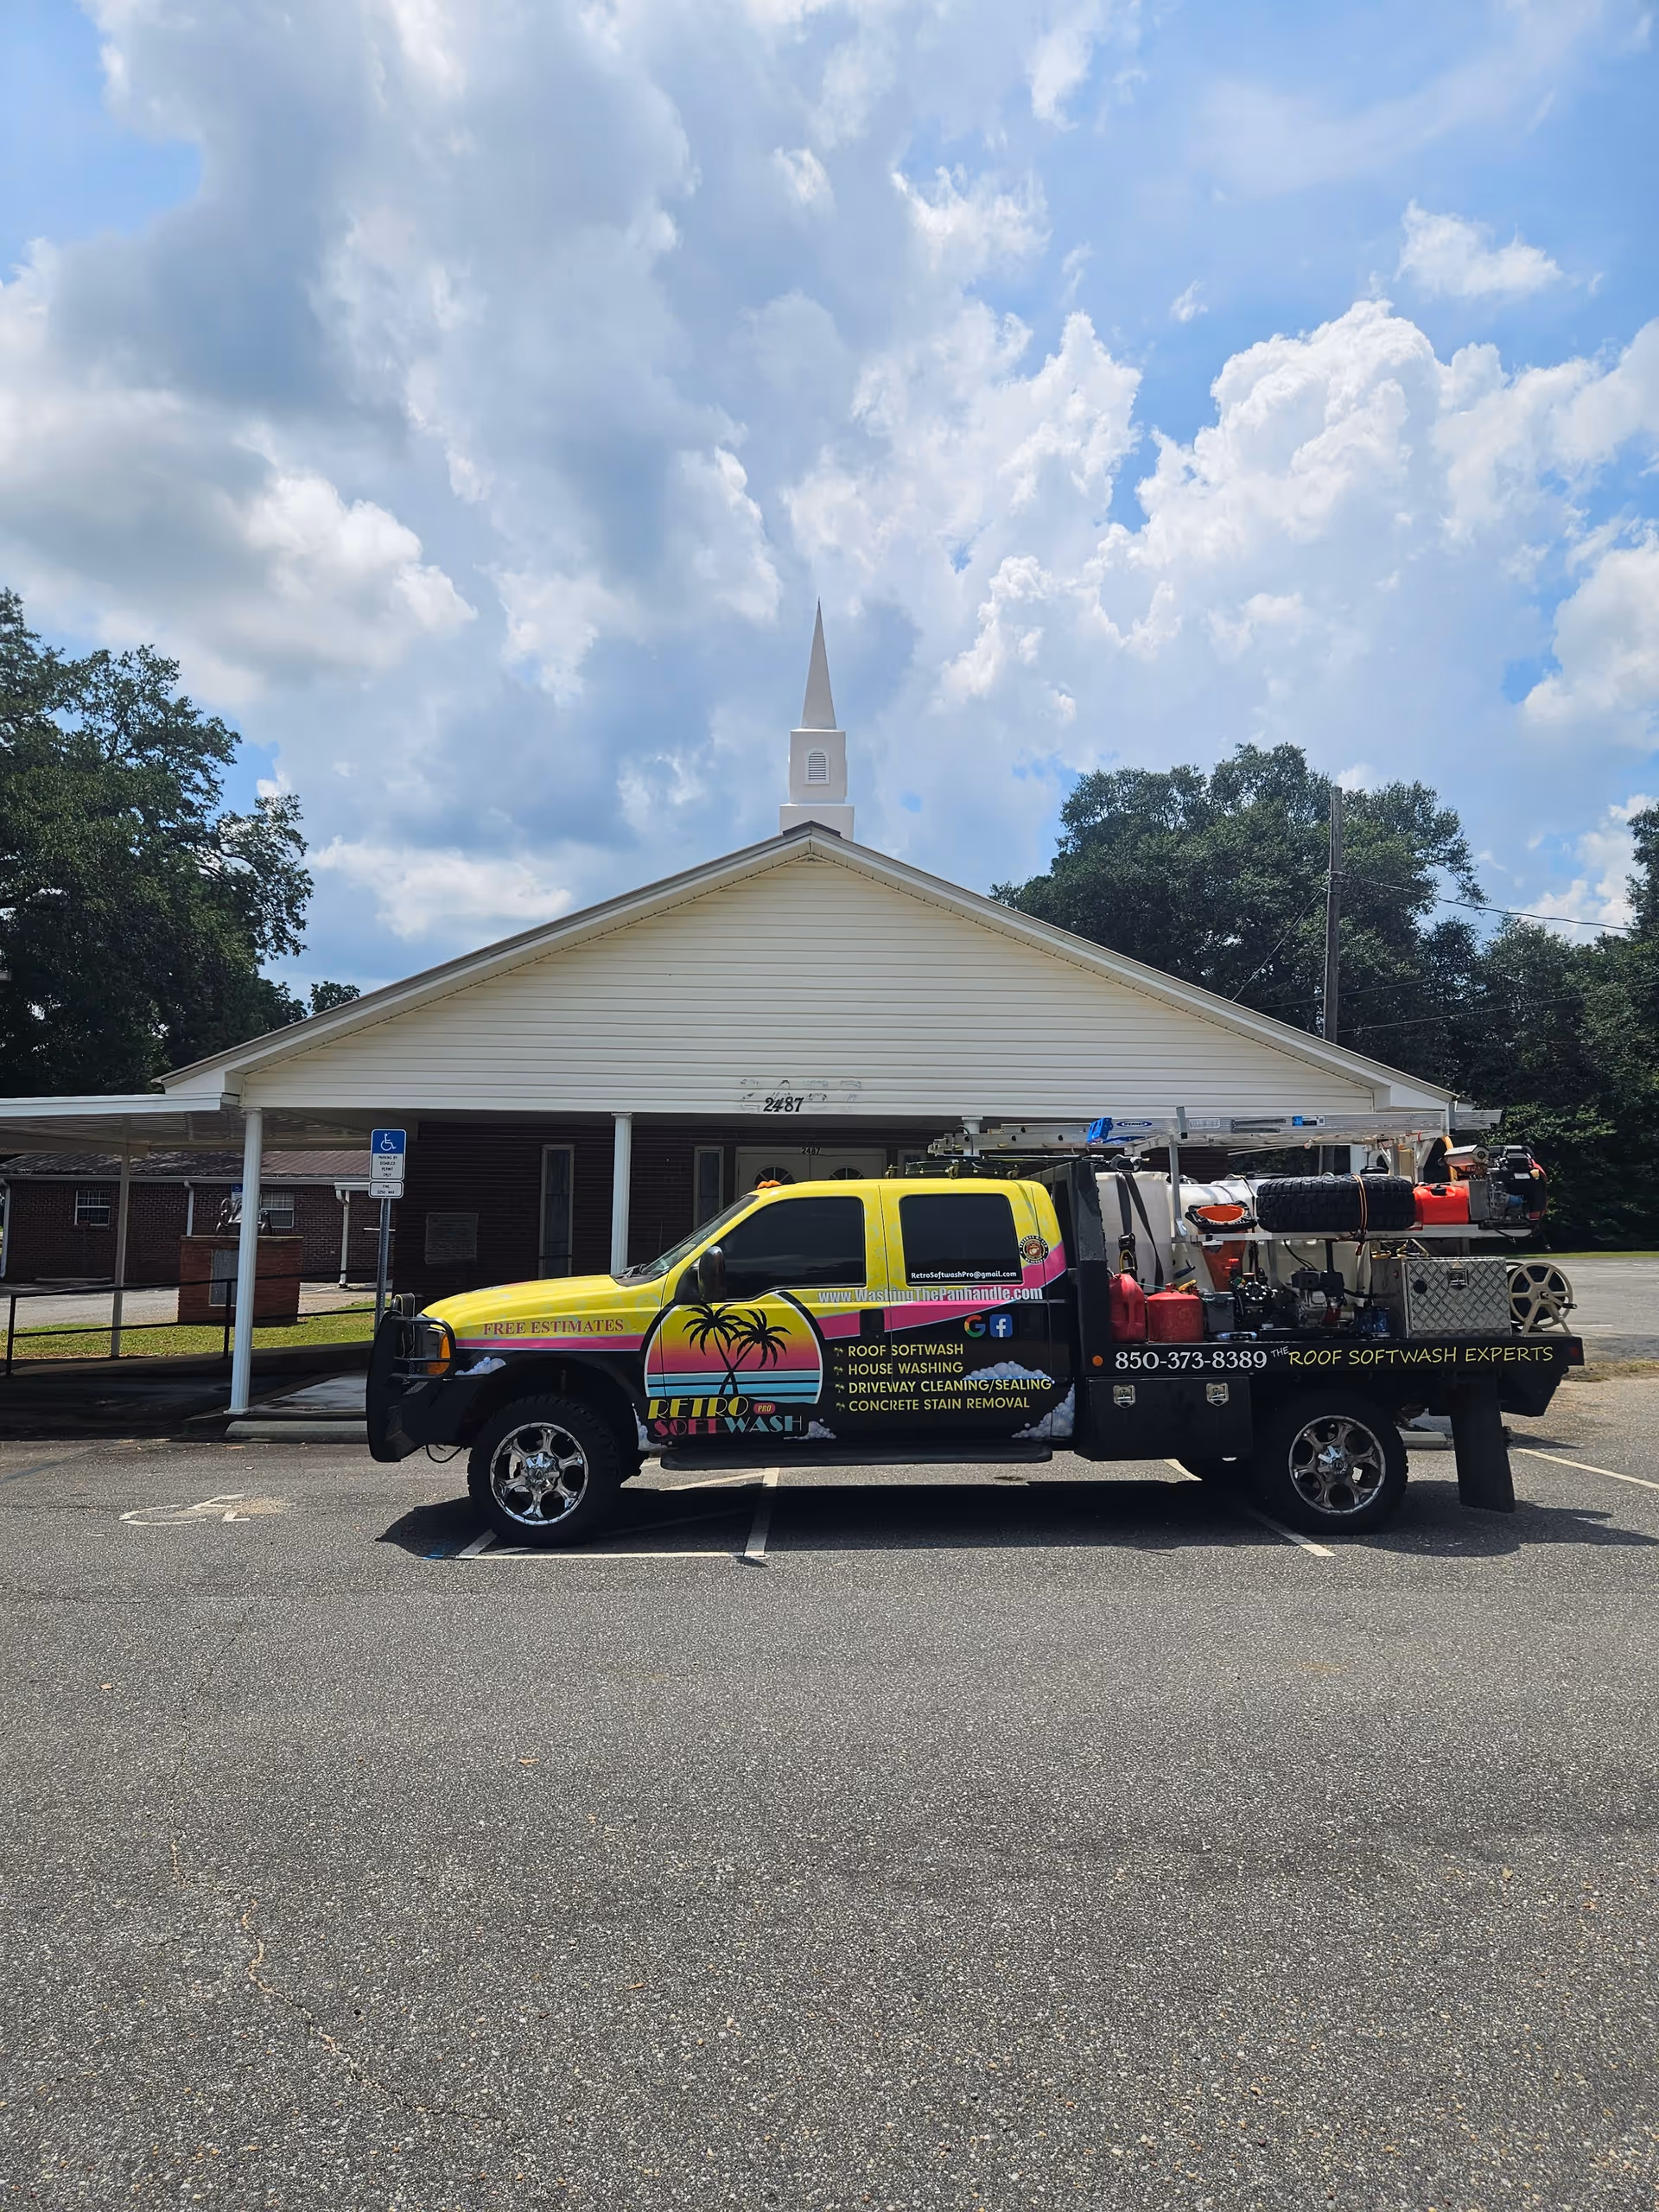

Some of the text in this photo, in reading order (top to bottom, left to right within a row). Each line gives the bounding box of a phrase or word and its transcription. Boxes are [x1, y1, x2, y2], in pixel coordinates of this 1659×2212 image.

[763, 1096, 804, 1113] 2487
[801, 1147, 821, 1155] 2487
[912, 1271, 1017, 1281] RetroSoftwashPro@gmail.com
[818, 1286, 1044, 1303] www.WashingThePanhandle.com
[484, 1319, 624, 1335] FREE ESTIMATES
[848, 1344, 963, 1357] ROOF SOFTWASH
[1115, 1346, 1554, 1370] 850-373-8389 THE ROOF SOFTWASH EXPERTS
[849, 1362, 963, 1376] HOUSE WASHING
[849, 1378, 1052, 1394] DRIVEWAY CLEANING/SEALING
[648, 1396, 772, 1420] RETRO PRO
[849, 1396, 1030, 1412] CONCRETE STAIN REMOVAL
